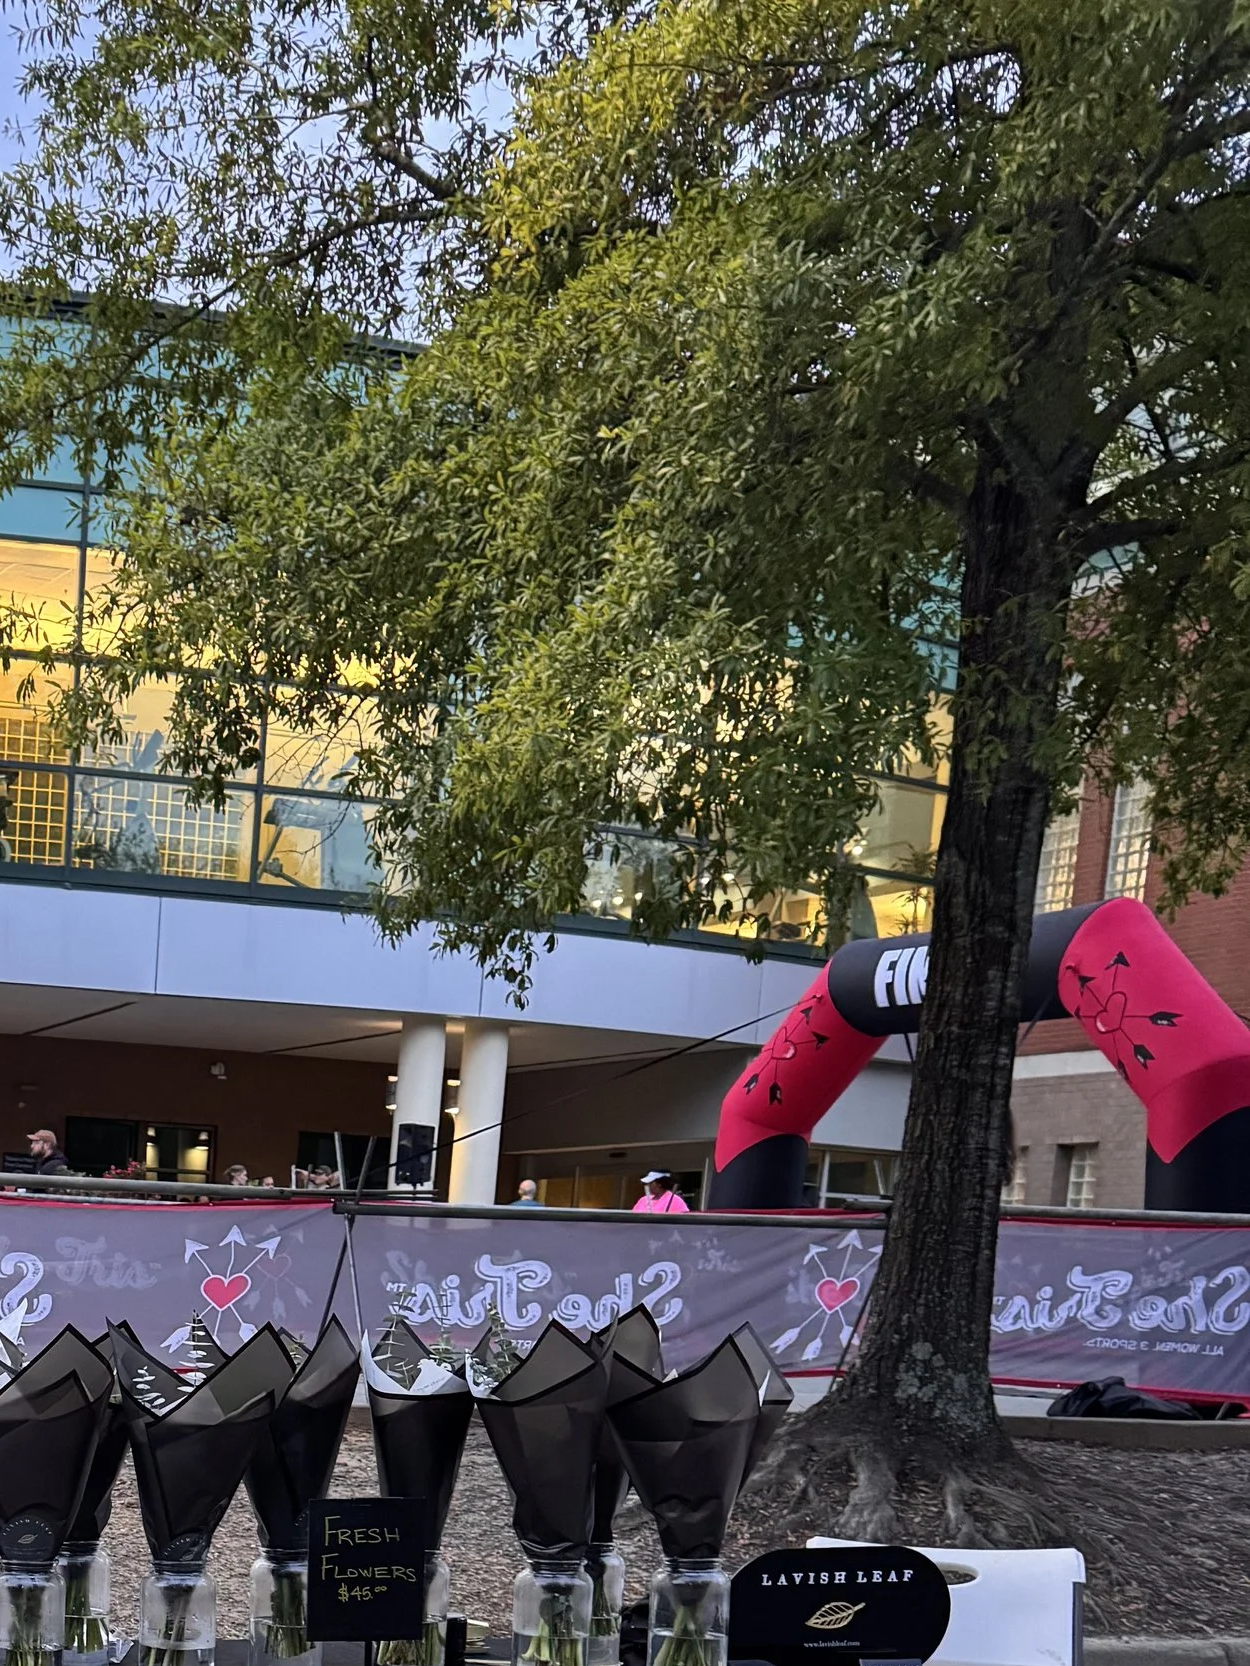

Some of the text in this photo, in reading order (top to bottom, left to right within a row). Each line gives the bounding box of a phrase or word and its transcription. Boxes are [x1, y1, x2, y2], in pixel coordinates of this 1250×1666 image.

[874, 945, 930, 1008] FIN
[325, 1516, 399, 1546] FRESH
[322, 1553, 416, 1582] FLOWERS
[762, 1570, 913, 1585] LAVISH LEAF
